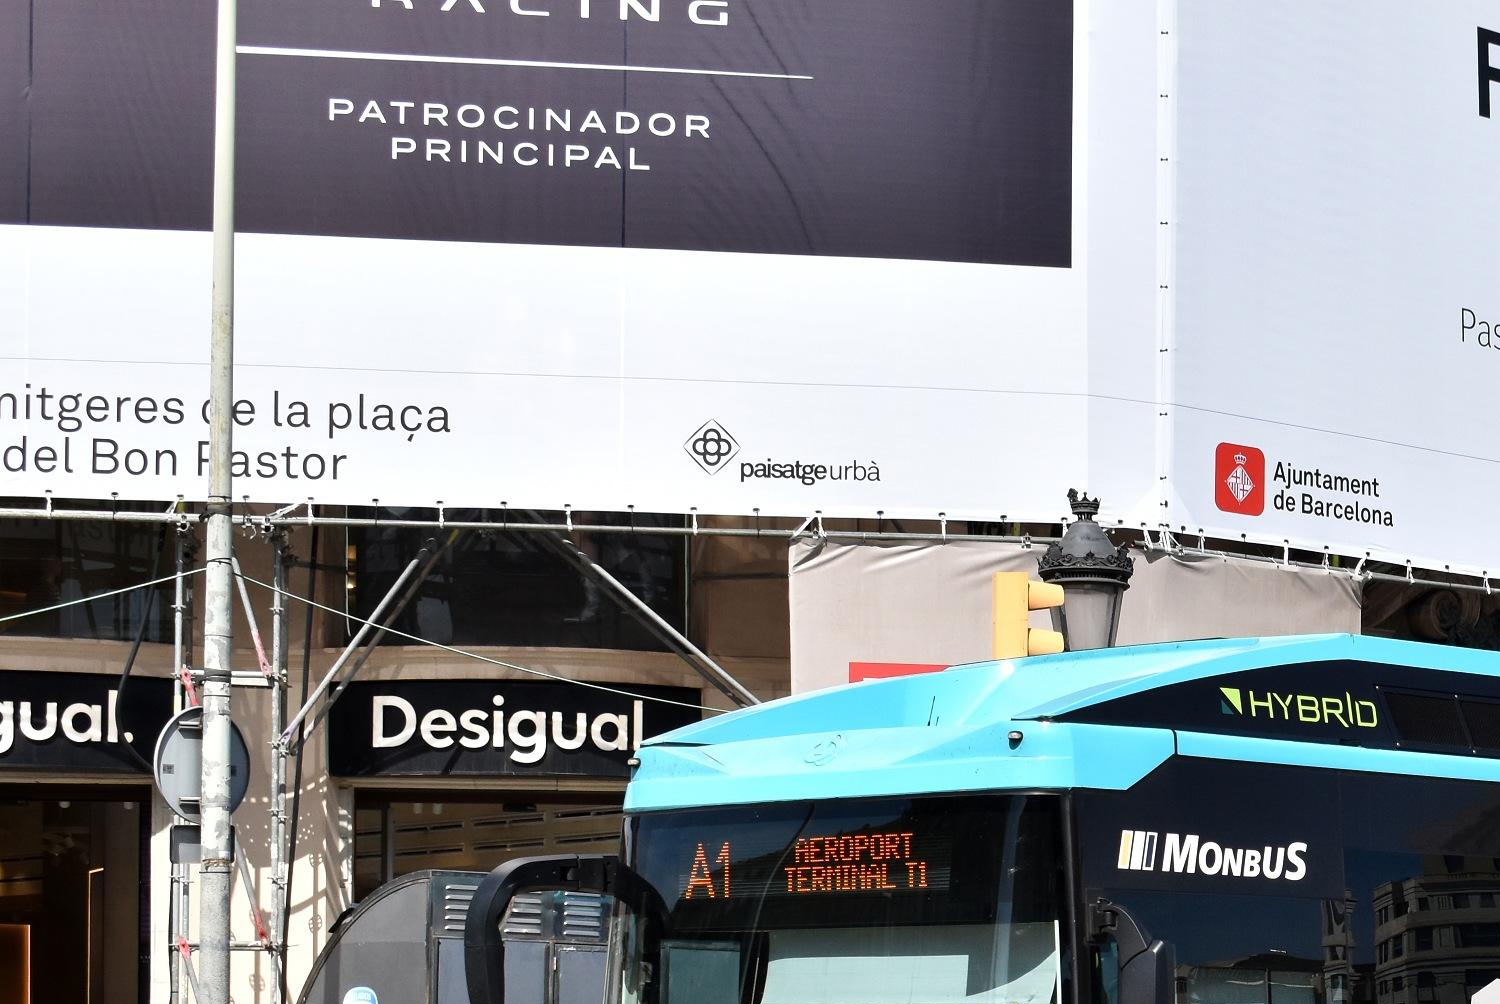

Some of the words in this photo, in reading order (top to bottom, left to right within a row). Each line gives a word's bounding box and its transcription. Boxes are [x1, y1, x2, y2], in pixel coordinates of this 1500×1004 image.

[328, 98, 711, 138] PATROCINADOR
[390, 137, 651, 171] PRINCIPAL
[273, 391, 311, 428] la
[329, 394, 451, 441] plaça
[3, 435, 73, 473] del
[92, 438, 177, 476] Bon
[1273, 461, 1380, 498] Ajuntament
[1273, 488, 1297, 513] de
[1301, 493, 1394, 527] Barcelona
[1250, 691, 1378, 728] HYBRID
[795, 832, 914, 863] AEROPORT
[686, 841, 730, 899] A1
[785, 863, 896, 892] TERMINAL
[905, 861, 928, 888] T1
